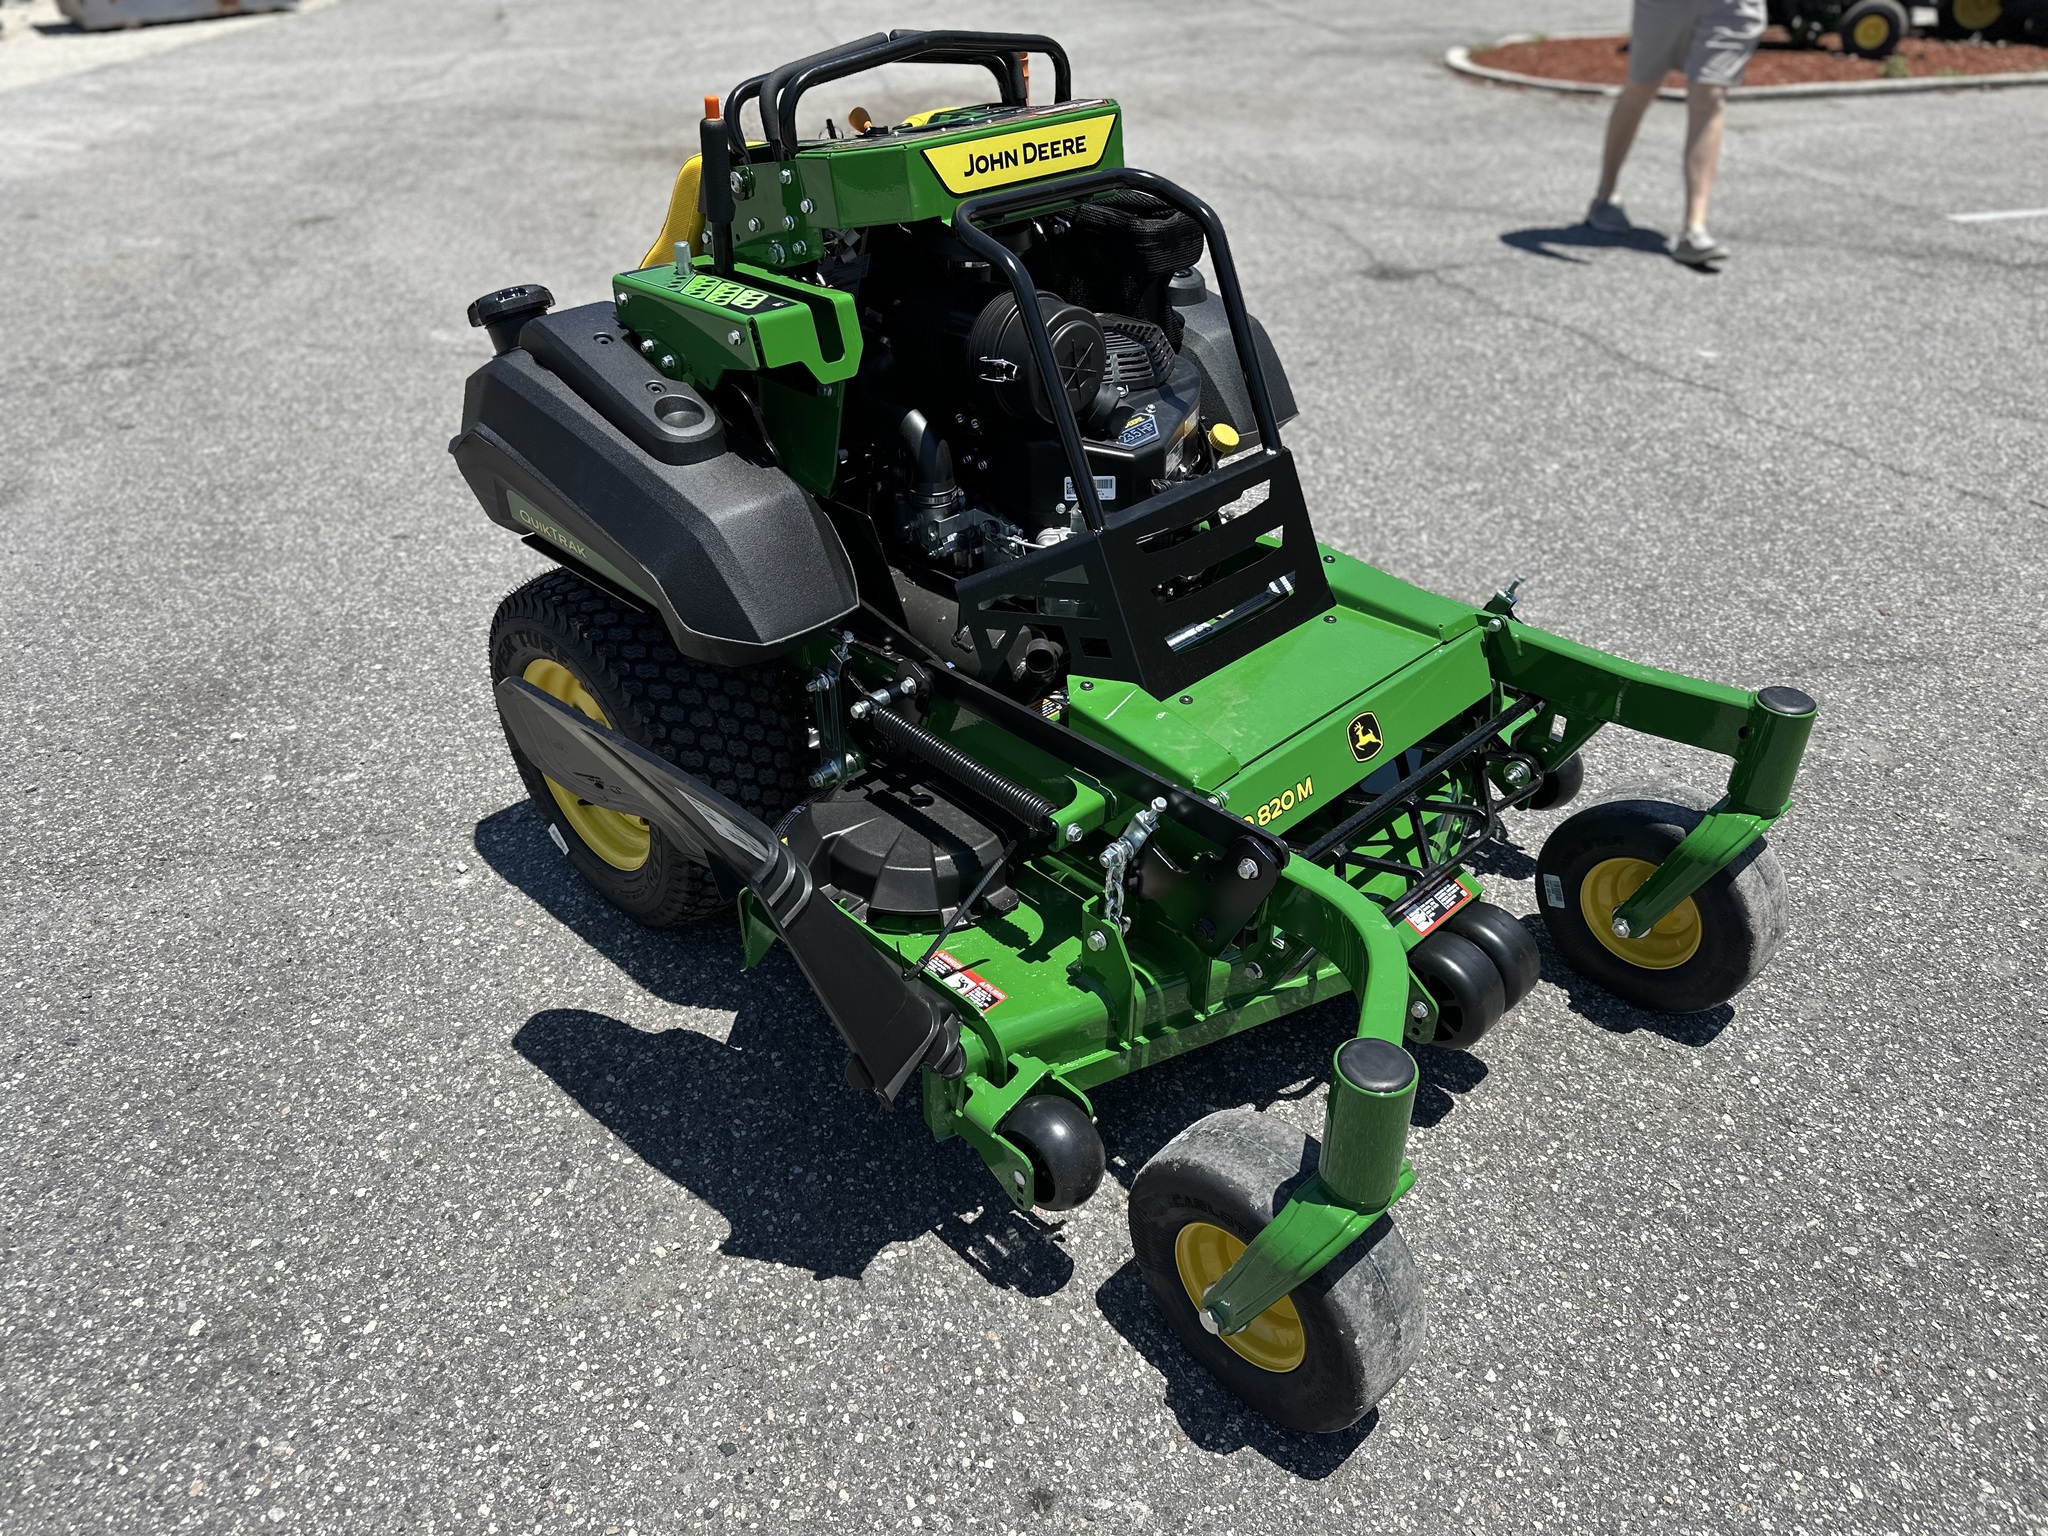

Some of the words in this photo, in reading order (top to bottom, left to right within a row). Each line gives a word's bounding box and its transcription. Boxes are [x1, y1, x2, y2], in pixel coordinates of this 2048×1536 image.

[964, 148, 1018, 177] JOHN
[1022, 135, 1087, 165] DEERE
[1137, 422, 1154, 434] HP
[519, 509, 587, 559] QUIKTRAK
